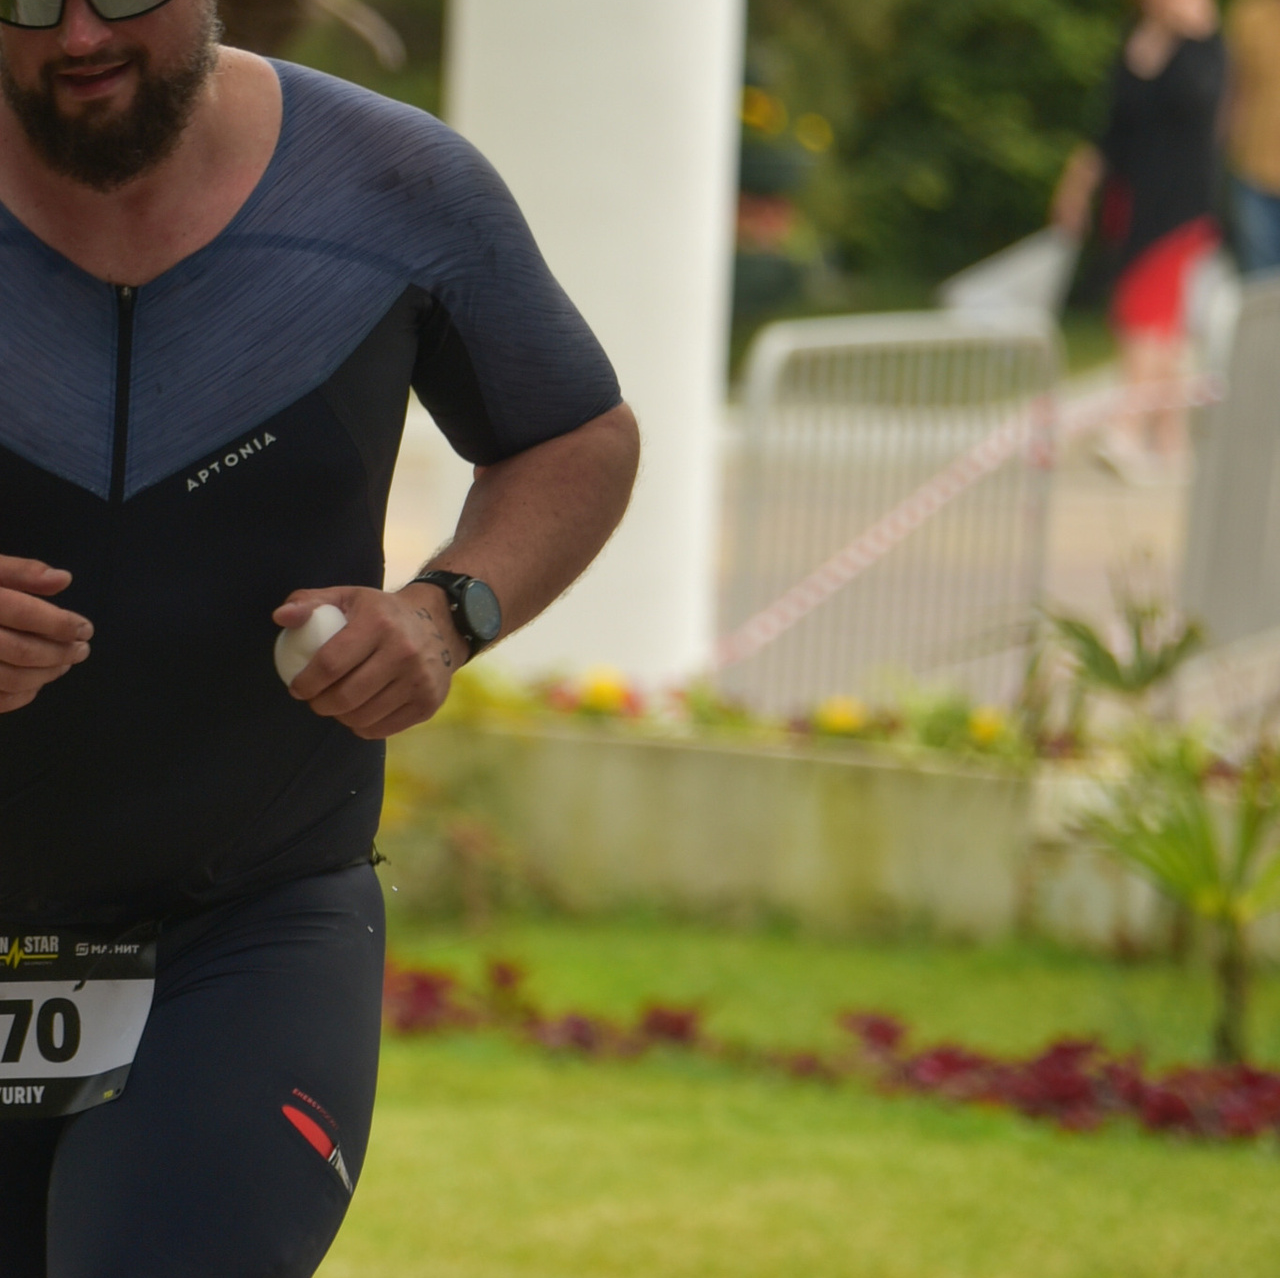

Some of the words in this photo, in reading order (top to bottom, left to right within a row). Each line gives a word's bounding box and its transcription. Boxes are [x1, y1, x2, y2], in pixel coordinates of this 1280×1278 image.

[186, 432, 277, 492] APTONIA
[23, 935, 59, 953] STAR
[91, 944, 140, 954] МАНИТ
